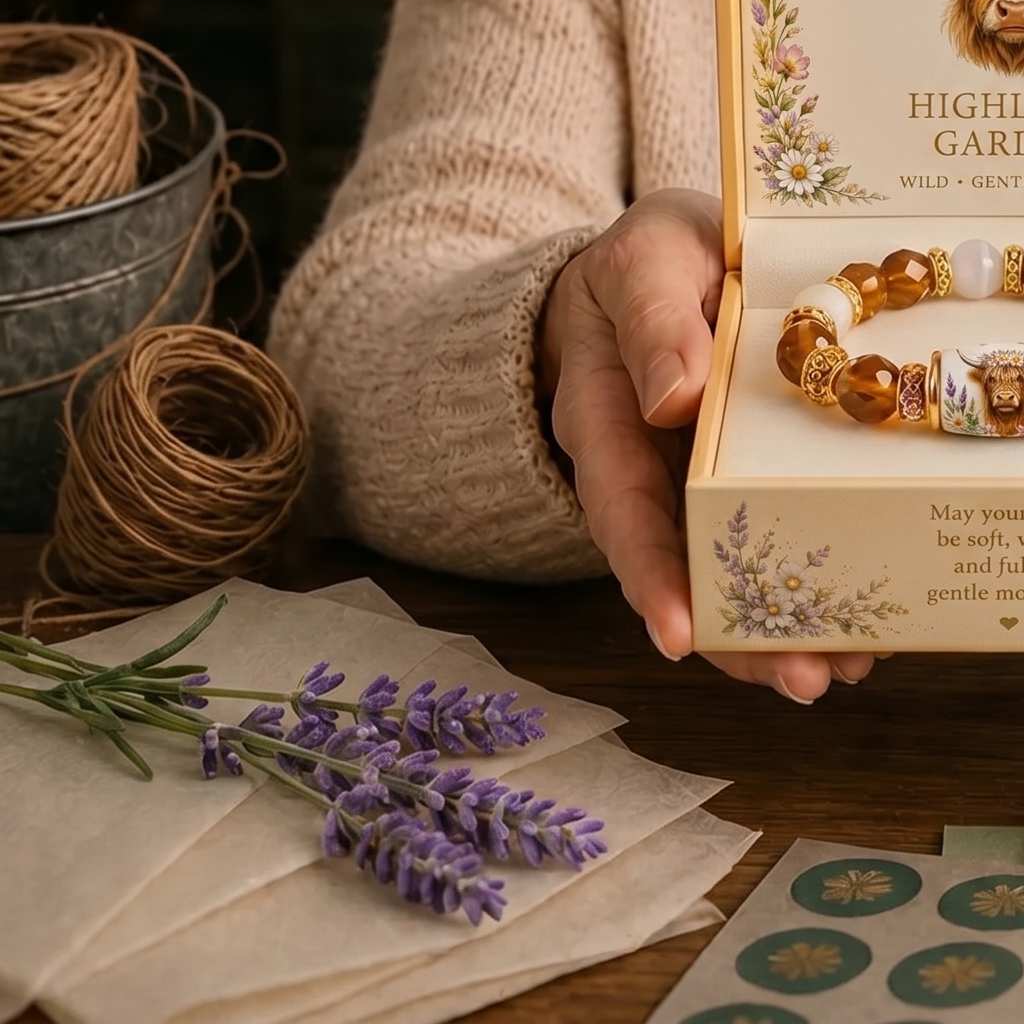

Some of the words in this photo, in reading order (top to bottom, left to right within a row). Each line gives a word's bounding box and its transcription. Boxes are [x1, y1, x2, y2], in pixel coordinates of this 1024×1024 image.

[899, 175, 949, 189] WILD
[930, 504, 975, 525] May
[937, 530, 961, 547] be
[967, 529, 1010, 551] soft,
[953, 556, 992, 574] and
[927, 583, 989, 605] gentle
